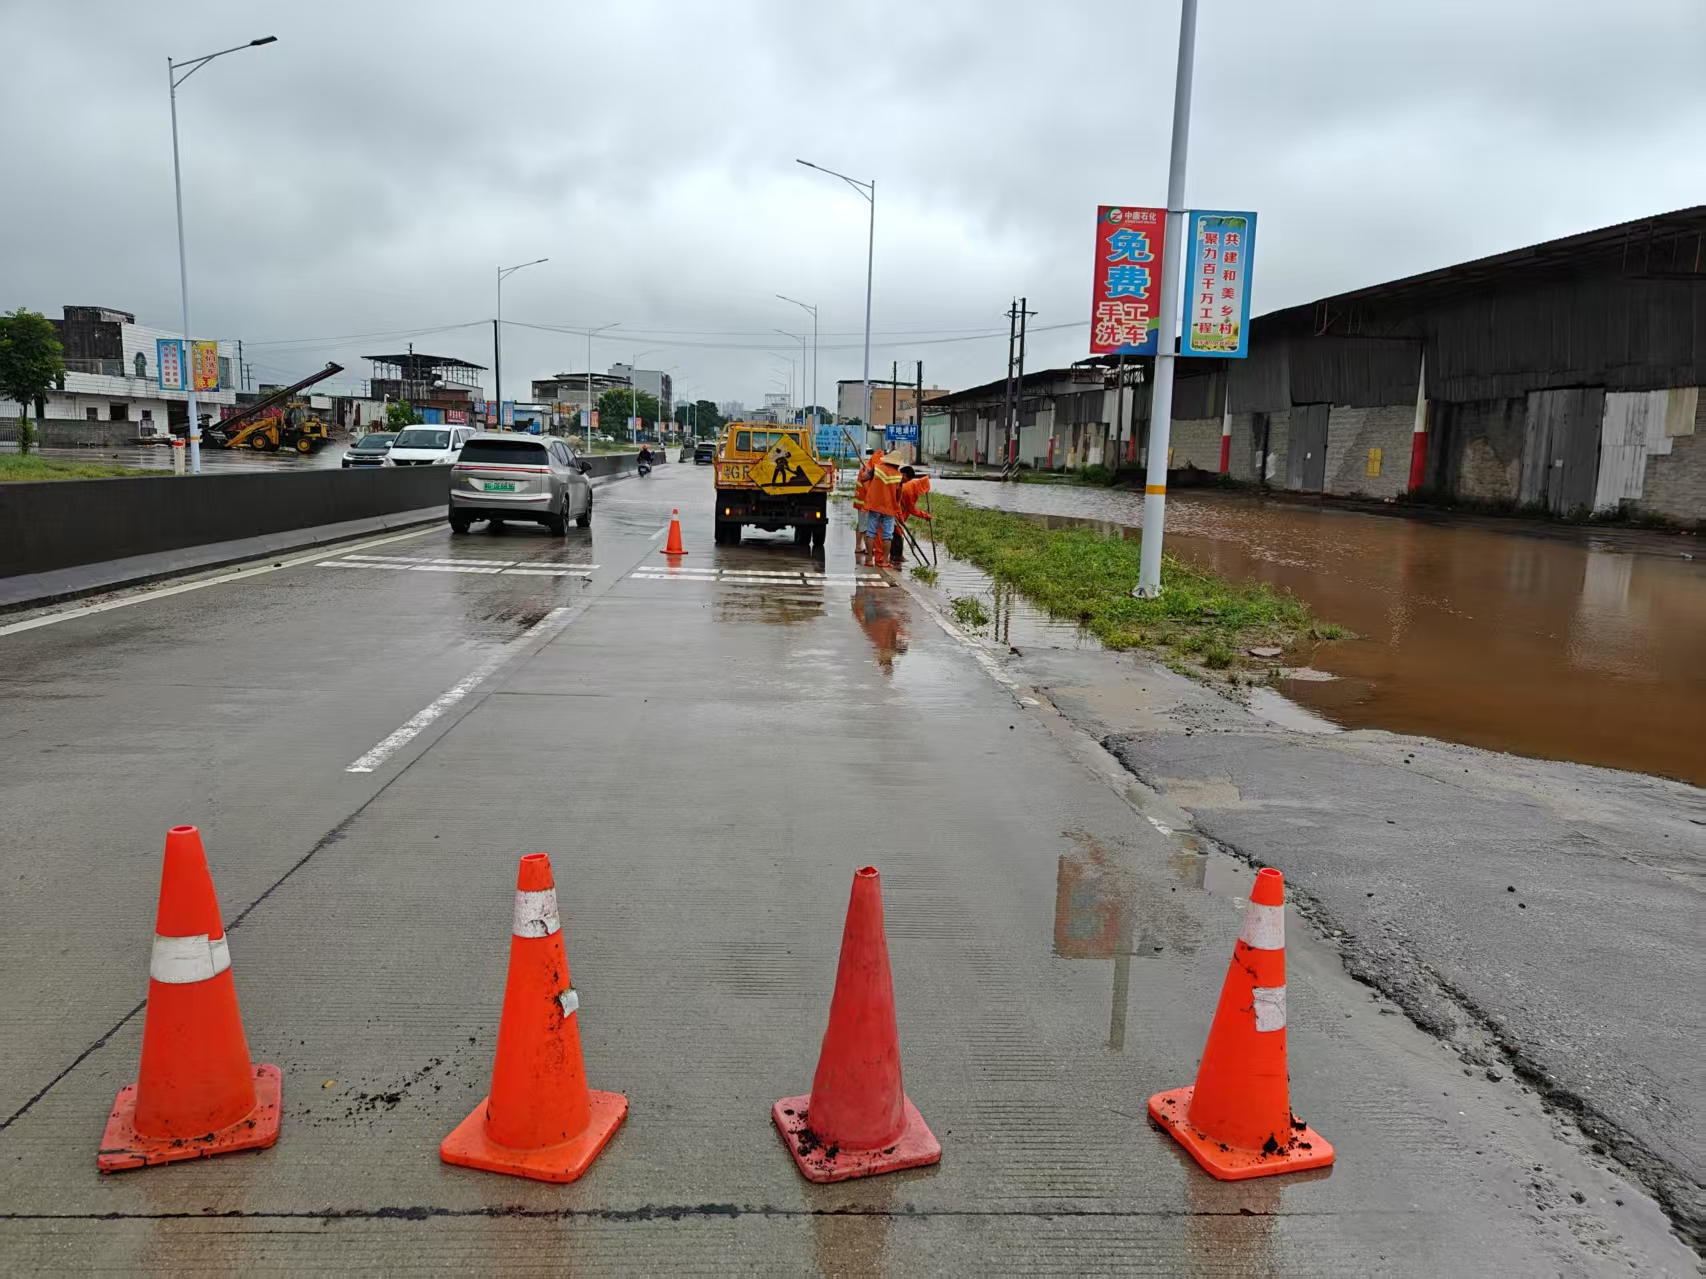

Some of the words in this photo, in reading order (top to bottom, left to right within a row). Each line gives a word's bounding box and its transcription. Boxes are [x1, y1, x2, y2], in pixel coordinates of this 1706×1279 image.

[1105, 228, 1154, 299] 免费
[1199, 233, 1219, 334] 聚力百千万工程
[1219, 233, 1240, 335] 共建和美乡村
[1095, 323, 1147, 346] 洗车
[1096, 302, 1149, 323] 手工
